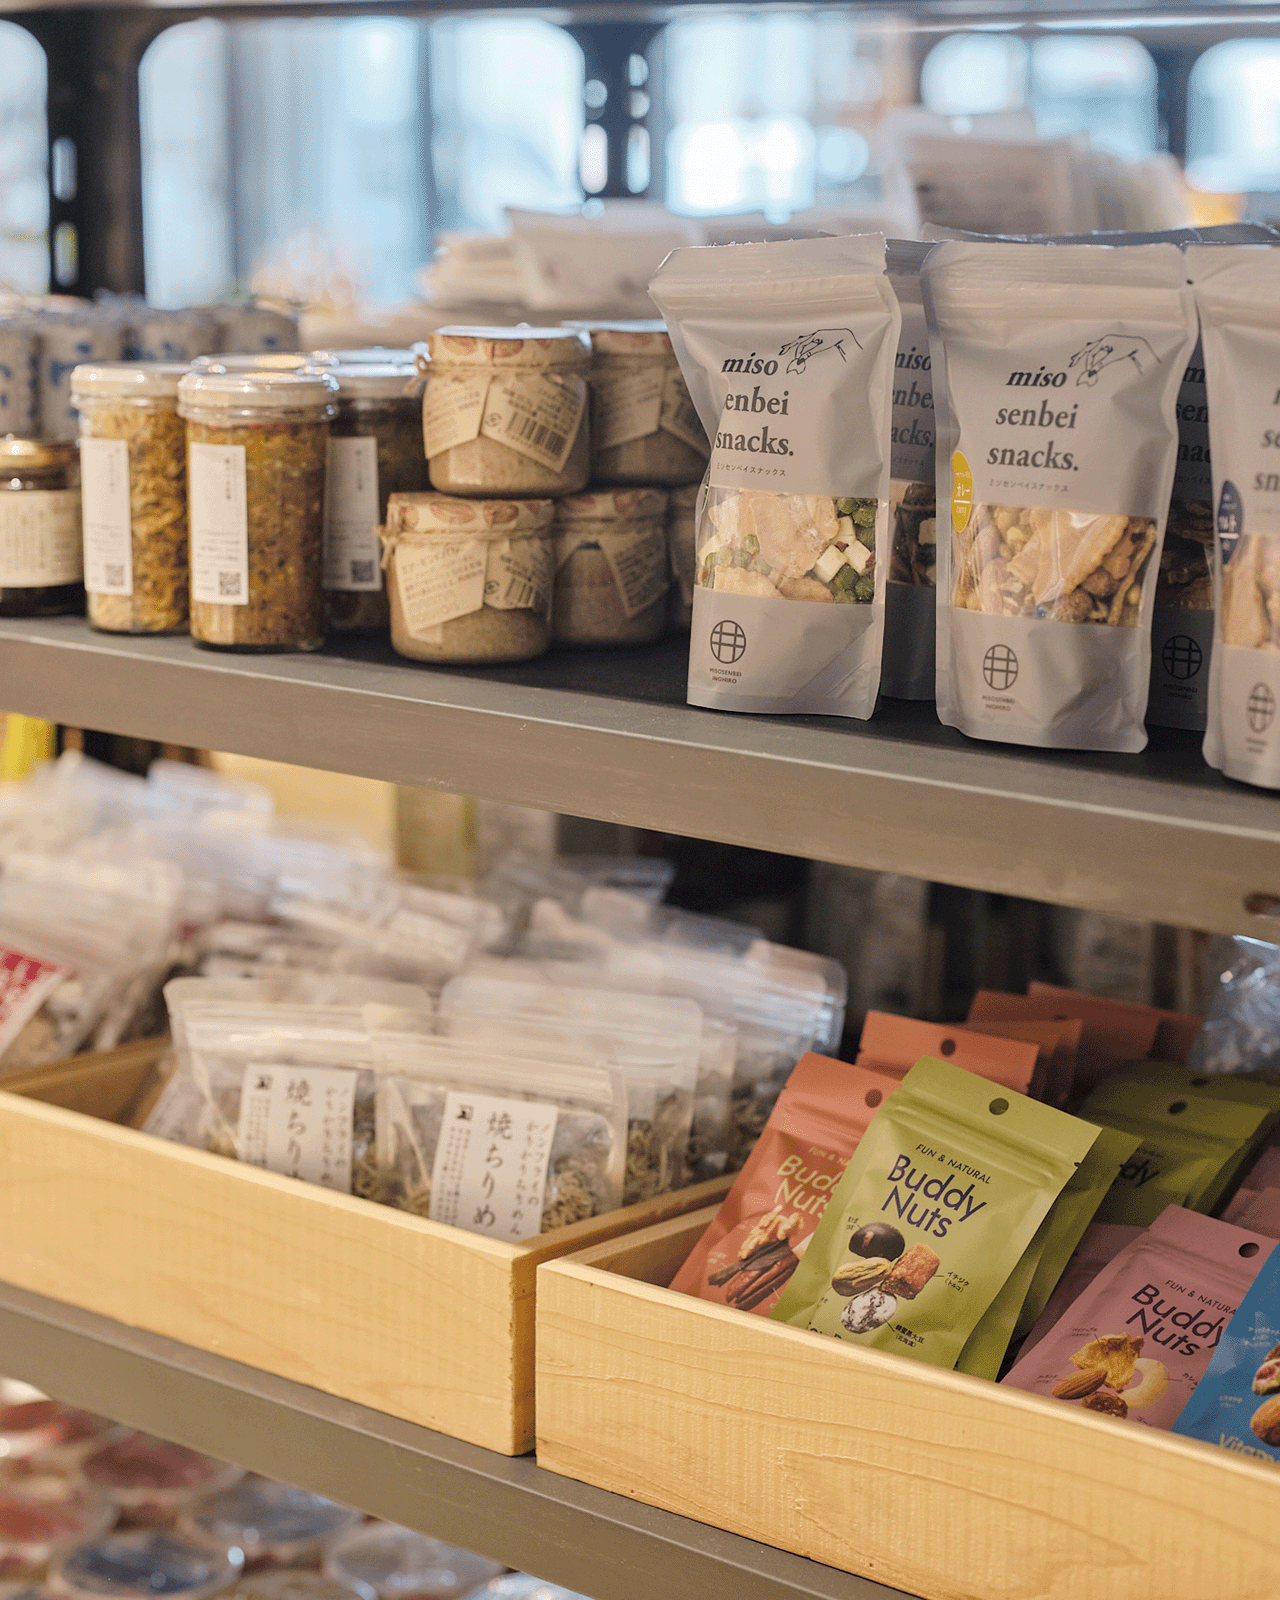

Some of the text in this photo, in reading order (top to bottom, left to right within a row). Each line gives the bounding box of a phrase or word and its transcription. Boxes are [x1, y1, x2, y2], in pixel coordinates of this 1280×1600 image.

[721, 352, 778, 376] miso
[1006, 366, 1067, 388] miso
[723, 385, 789, 416] enbei
[996, 399, 1079, 429] senbei
[716, 426, 794, 457] snacks.
[891, 419, 934, 448] acks.
[987, 440, 1079, 471] snacks.
[710, 667, 742, 677] MISOSENBEI
[777, 1155, 844, 1194] Bud
[915, 1143, 991, 1184] FUN & NATURAL
[887, 1154, 987, 1222] Buddy
[881, 1185, 952, 1238] Nuts
[1165, 1279, 1237, 1315] FUN & NATURA
[1125, 1307, 1201, 1356] Nuts
